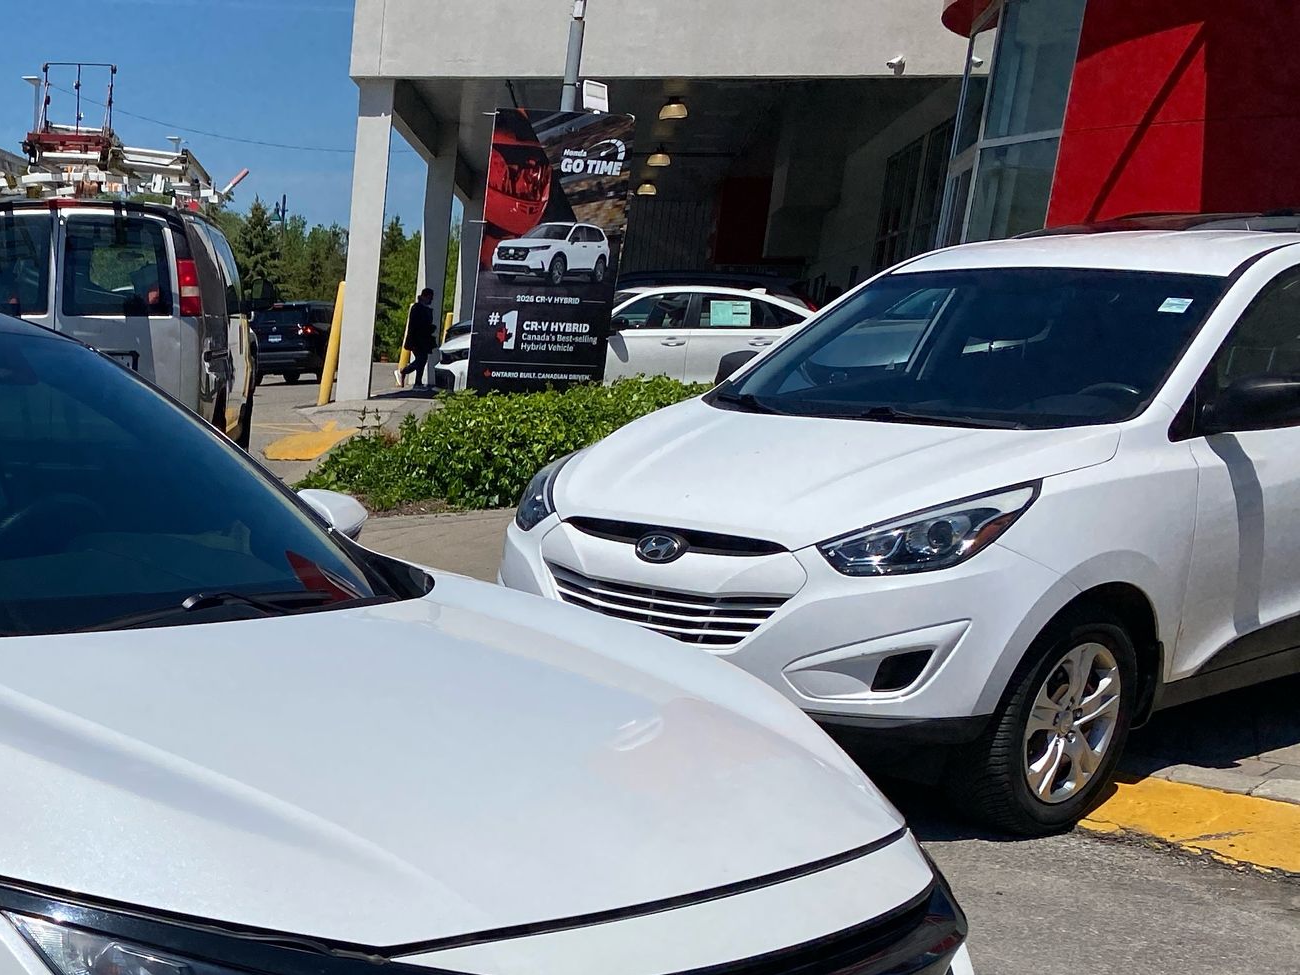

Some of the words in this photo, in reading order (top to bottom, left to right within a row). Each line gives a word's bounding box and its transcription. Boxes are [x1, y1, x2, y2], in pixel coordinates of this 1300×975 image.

[563, 149, 587, 157] Honda
[561, 158, 584, 173] GO
[587, 160, 623, 176] TIME
[535, 296, 553, 304] CR-V
[523, 321, 549, 332] CR-V
[550, 322, 590, 333] HYBRID
[521, 333, 555, 342] Canada's
[556, 334, 597, 345] Best-selling
[520, 342, 546, 352] Hybrid
